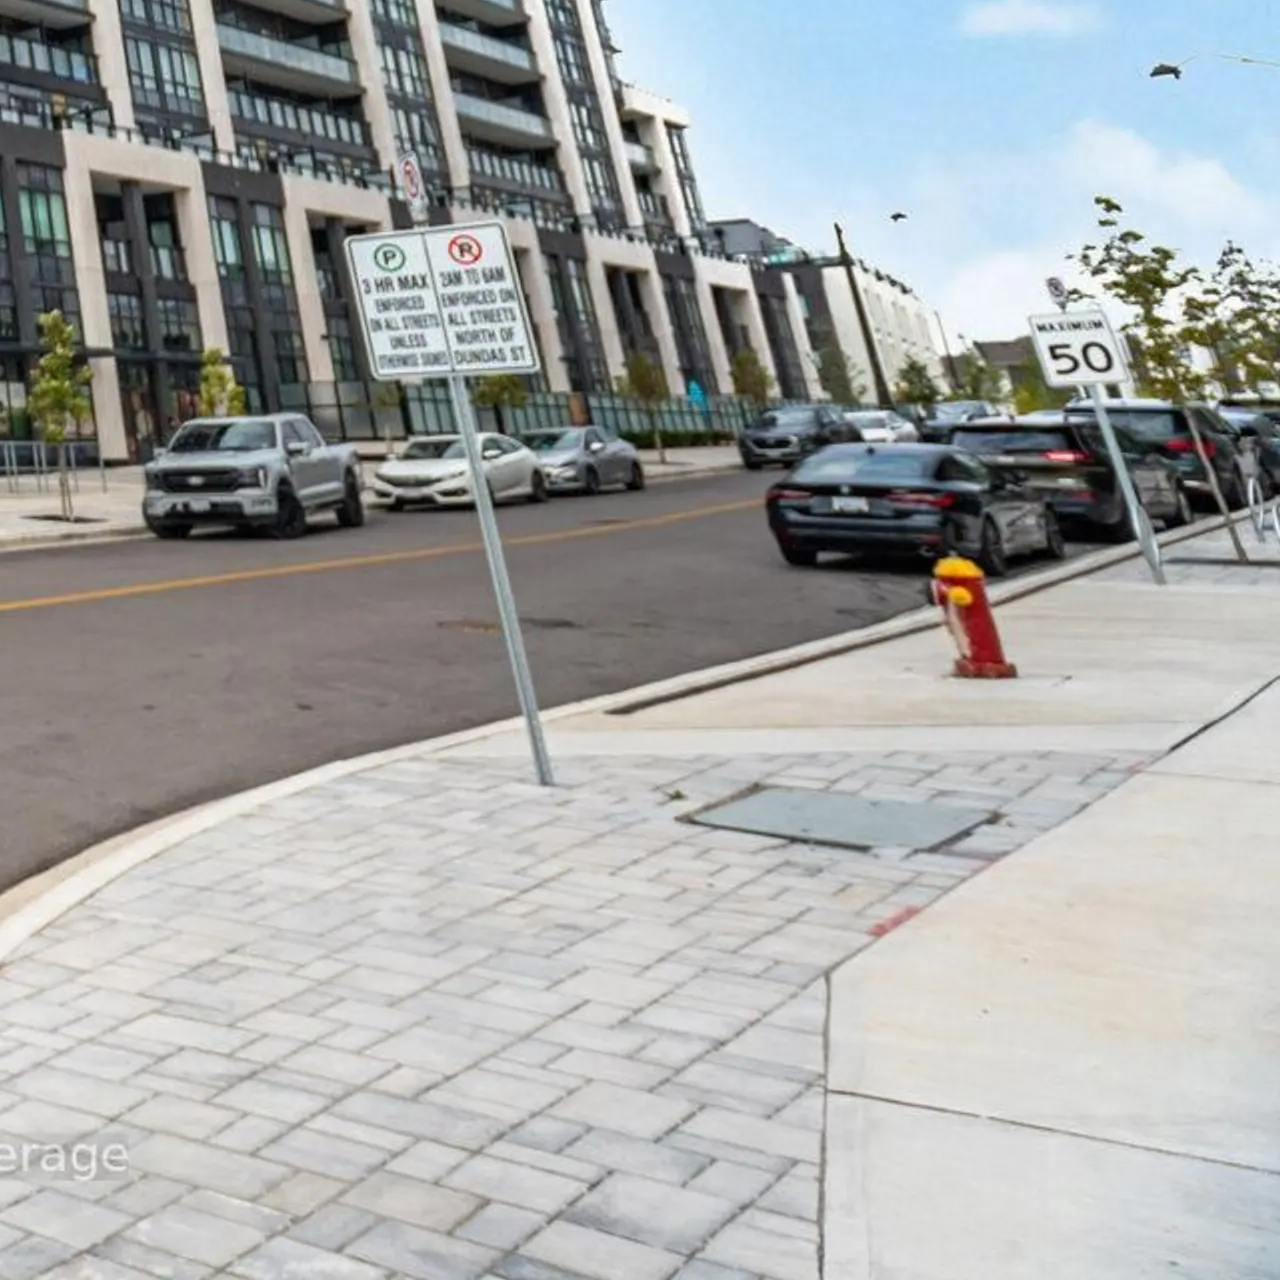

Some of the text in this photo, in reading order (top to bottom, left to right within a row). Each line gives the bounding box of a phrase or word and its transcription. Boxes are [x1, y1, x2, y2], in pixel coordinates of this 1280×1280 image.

[375, 277, 395, 293] HR
[398, 273, 430, 290] MAX
[464, 269, 480, 284] TO
[376, 295, 425, 313] ENFORCED
[441, 288, 516, 307] ENFORCED ON
[402, 314, 440, 330] STREETS
[448, 307, 517, 325] ALL STREETS
[1036, 321, 1104, 332] MAXIMUM
[390, 333, 427, 349] UNLESS
[455, 327, 515, 345] NORTH OF
[454, 346, 525, 365] DUNDAS ST
[1048, 342, 1113, 375] 50
